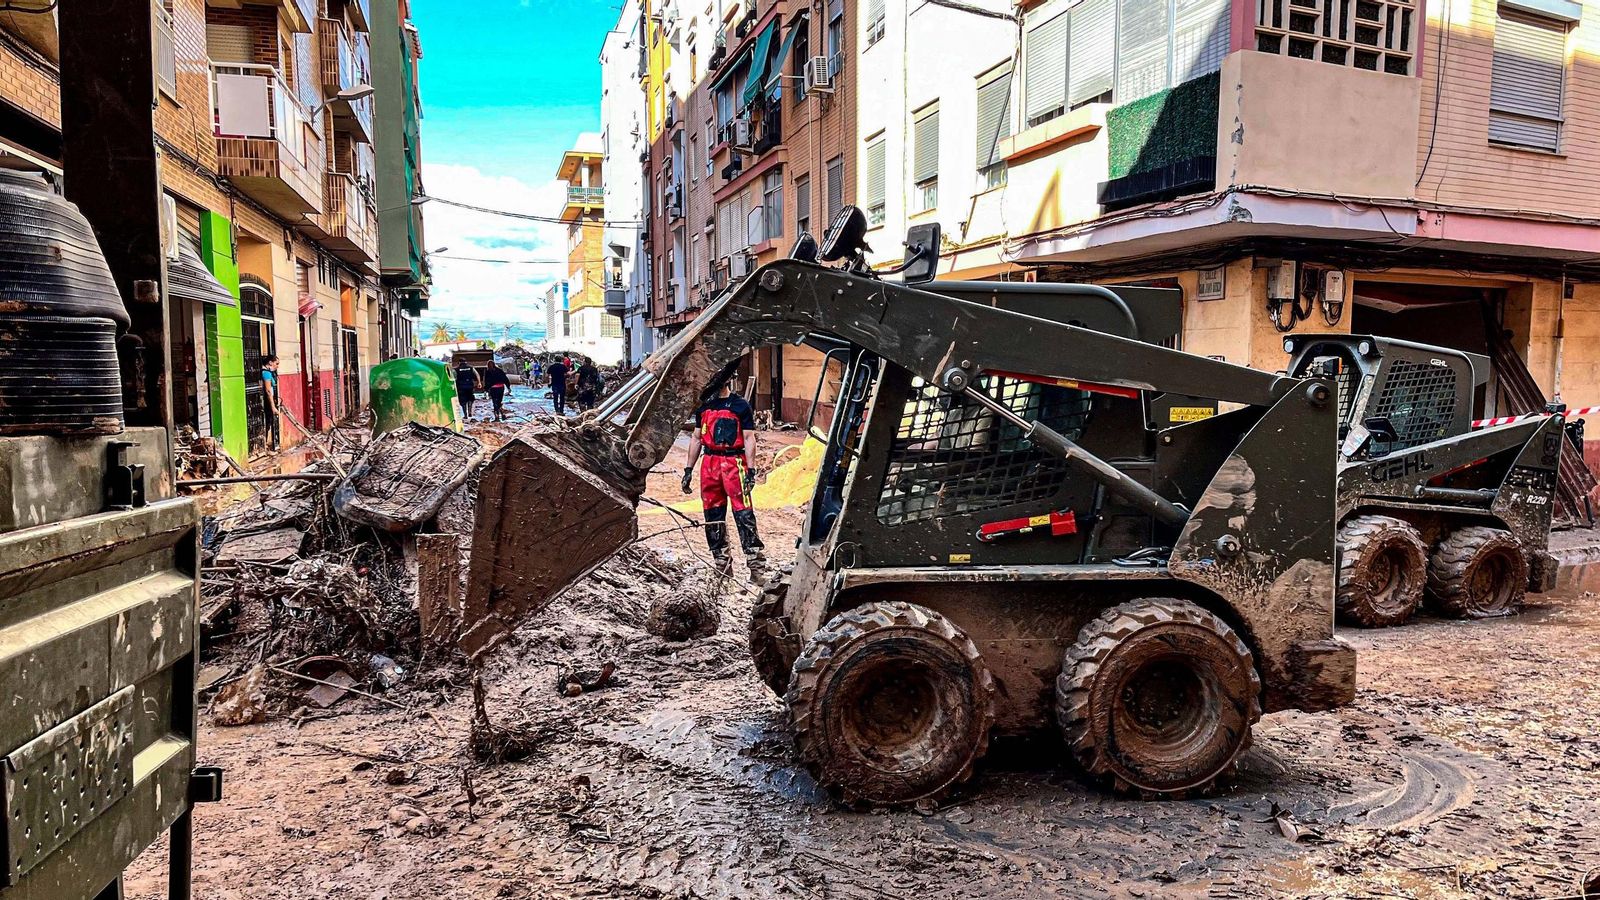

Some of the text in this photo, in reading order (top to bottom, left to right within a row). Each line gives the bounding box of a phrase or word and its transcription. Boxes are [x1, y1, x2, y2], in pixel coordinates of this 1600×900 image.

[1430, 358, 1448, 368] GEHL
[1371, 451, 1434, 483] GEHL
[1526, 494, 1548, 505] R220
